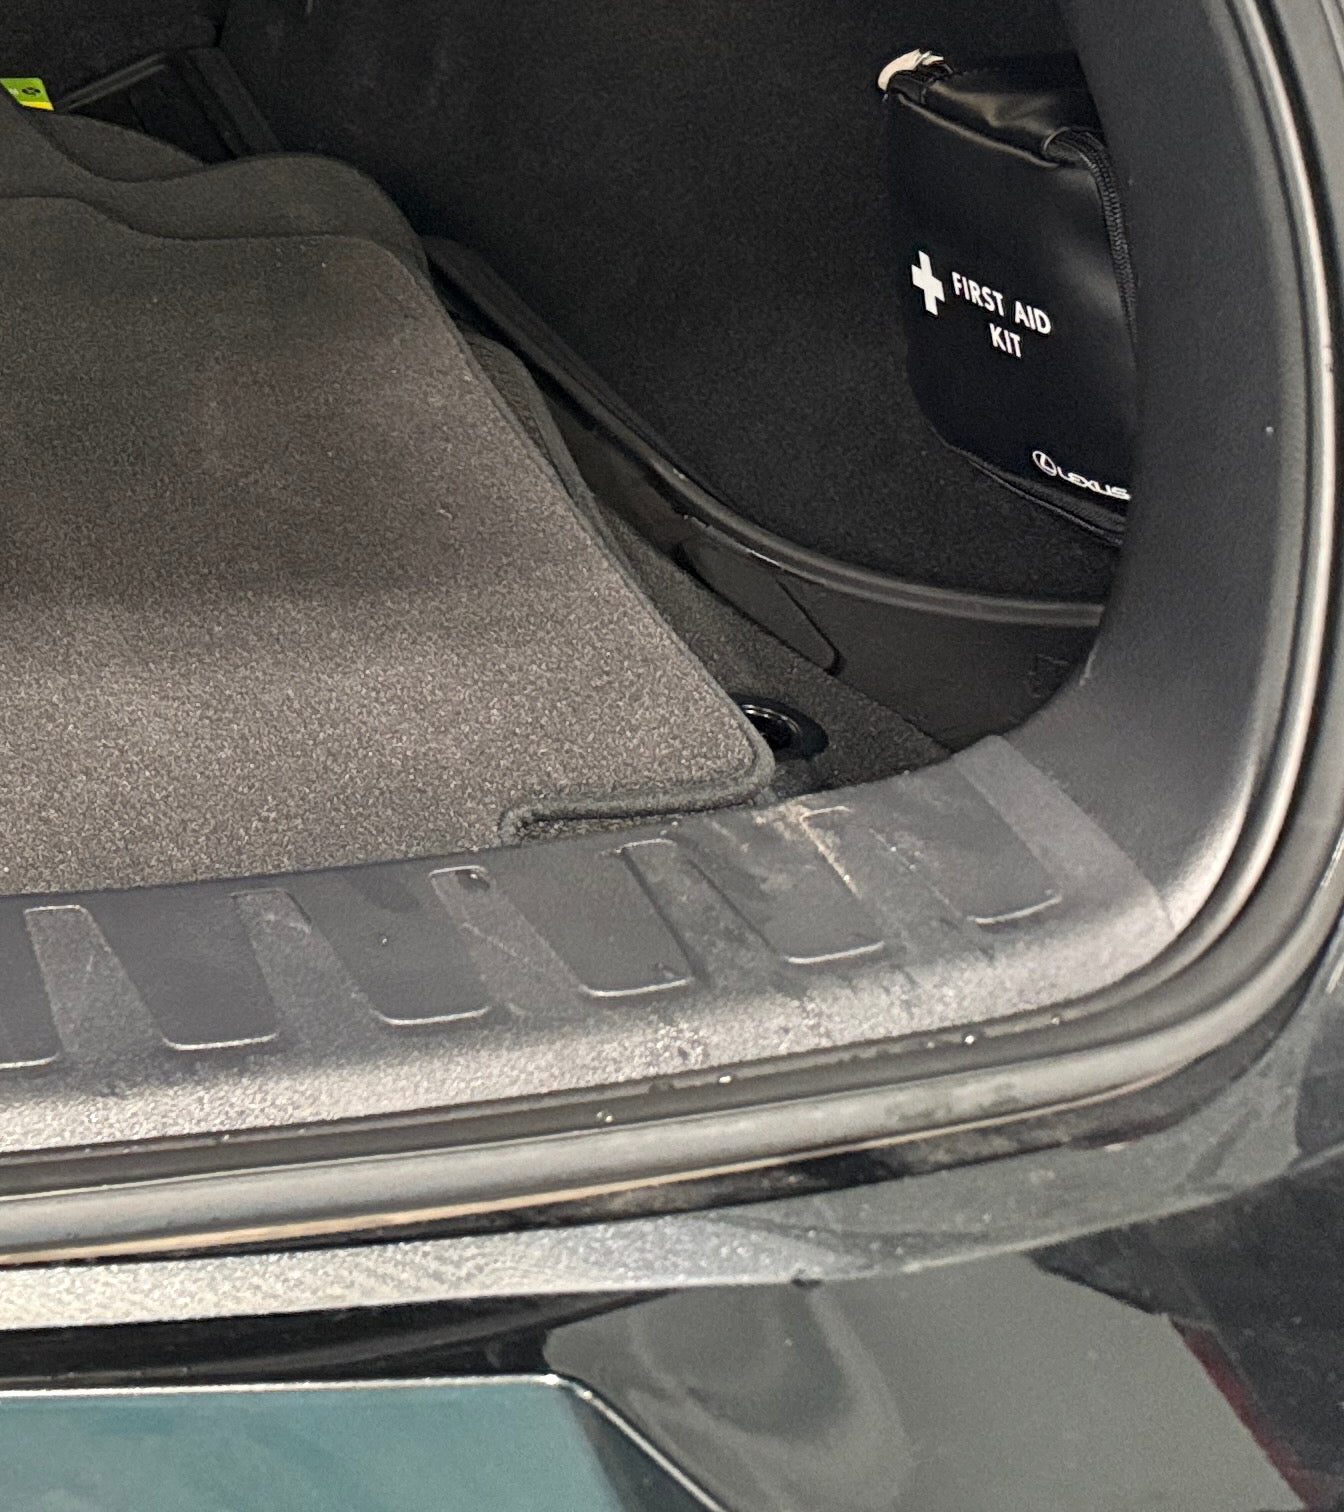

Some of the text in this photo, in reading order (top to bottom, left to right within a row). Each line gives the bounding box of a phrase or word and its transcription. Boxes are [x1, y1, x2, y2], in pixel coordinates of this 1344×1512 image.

[952, 271, 1052, 335] FIRST AID
[989, 322, 1022, 359] KIT
[1056, 466, 1131, 501] LEXUS
